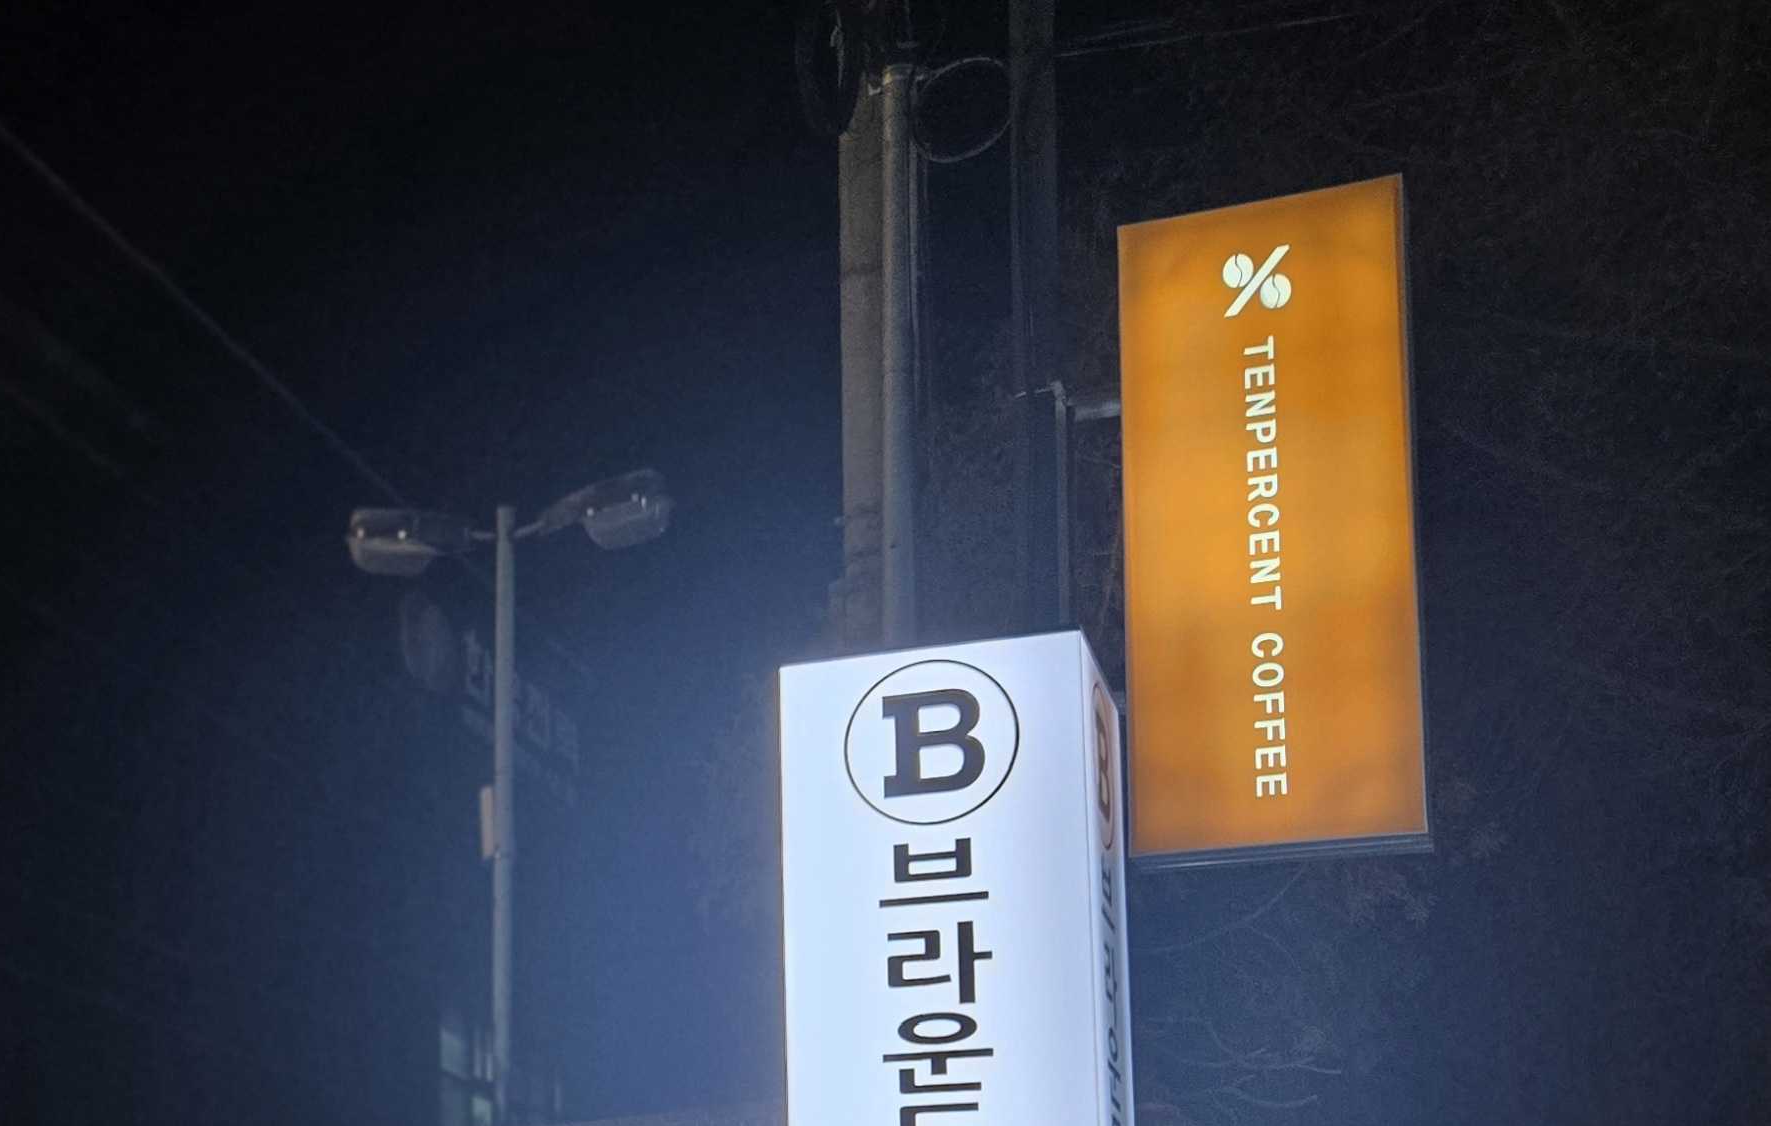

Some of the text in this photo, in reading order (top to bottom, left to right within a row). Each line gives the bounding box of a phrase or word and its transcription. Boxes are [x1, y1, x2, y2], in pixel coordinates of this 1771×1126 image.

[1243, 334, 1284, 612] TENPERCENT
[881, 688, 986, 800] B
[1250, 631, 1290, 799] COFFEE
